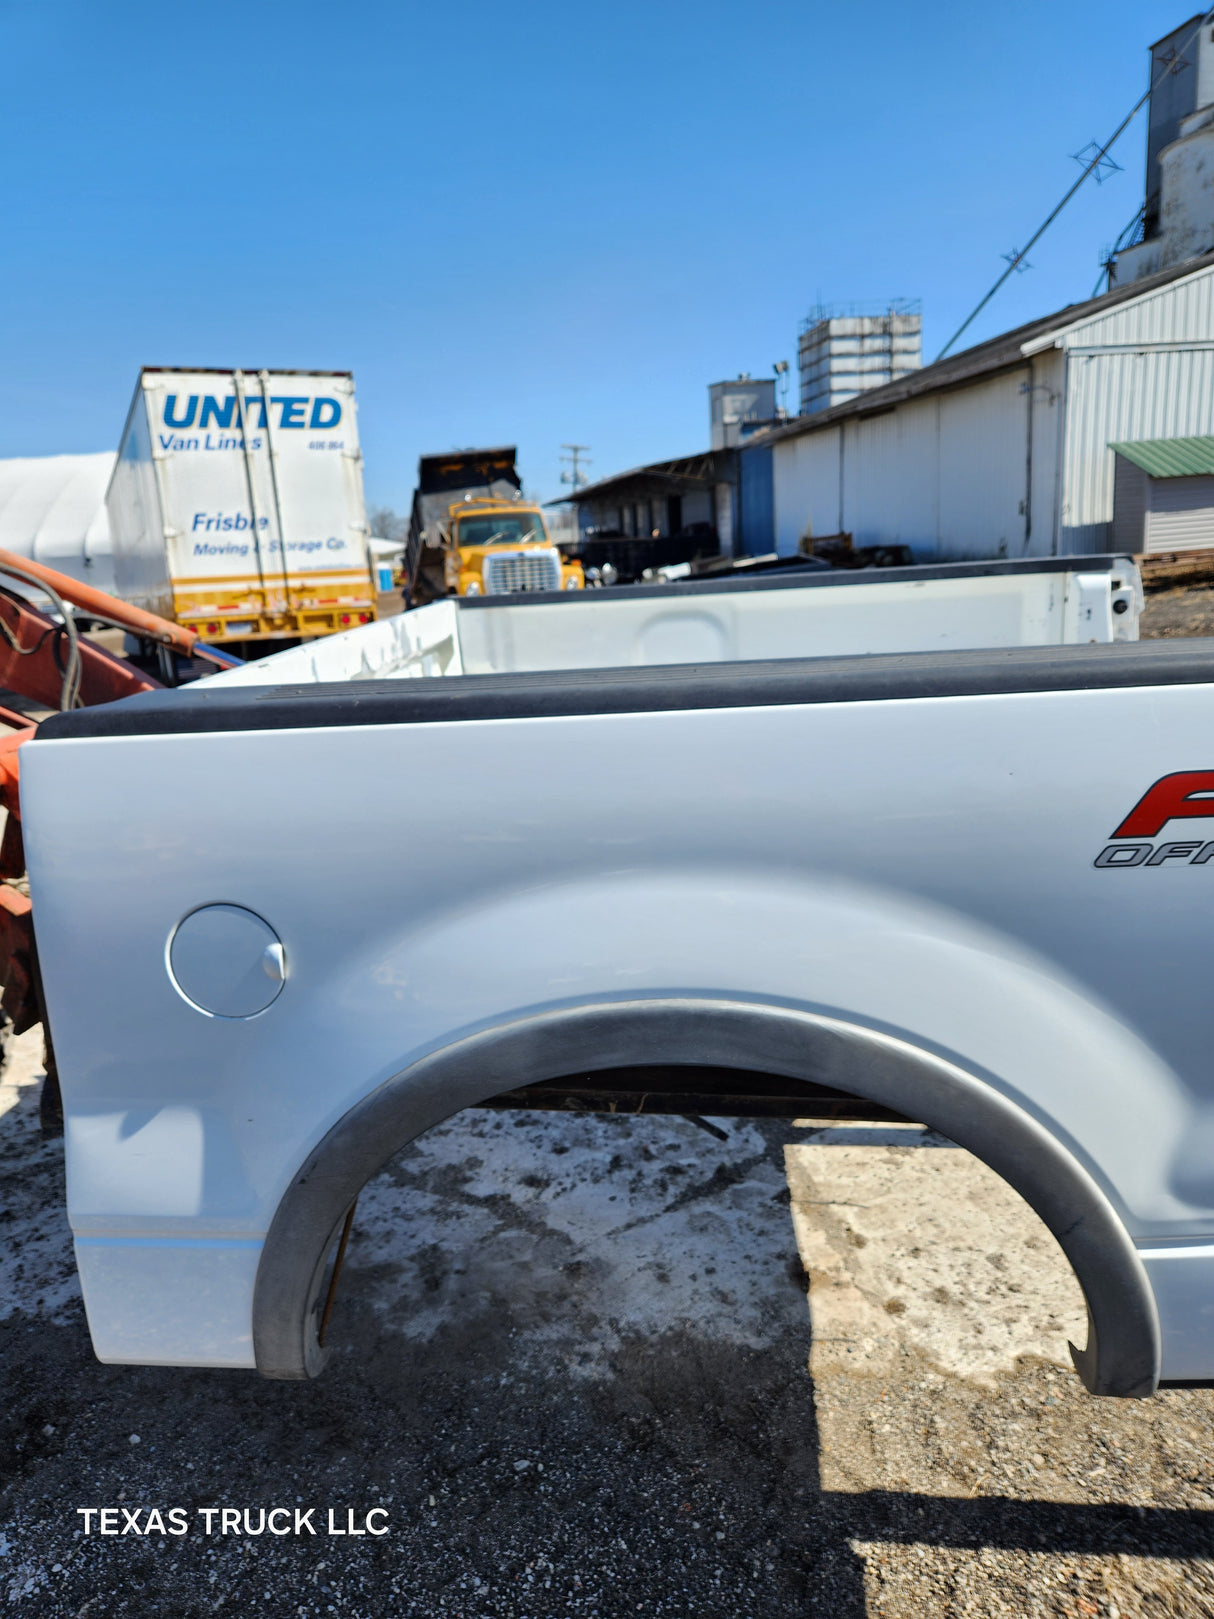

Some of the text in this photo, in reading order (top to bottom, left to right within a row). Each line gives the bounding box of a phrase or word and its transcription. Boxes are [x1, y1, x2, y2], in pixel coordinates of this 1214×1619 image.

[163, 394, 342, 430] UNITED
[159, 434, 199, 451] Van
[193, 541, 249, 557] Moving
